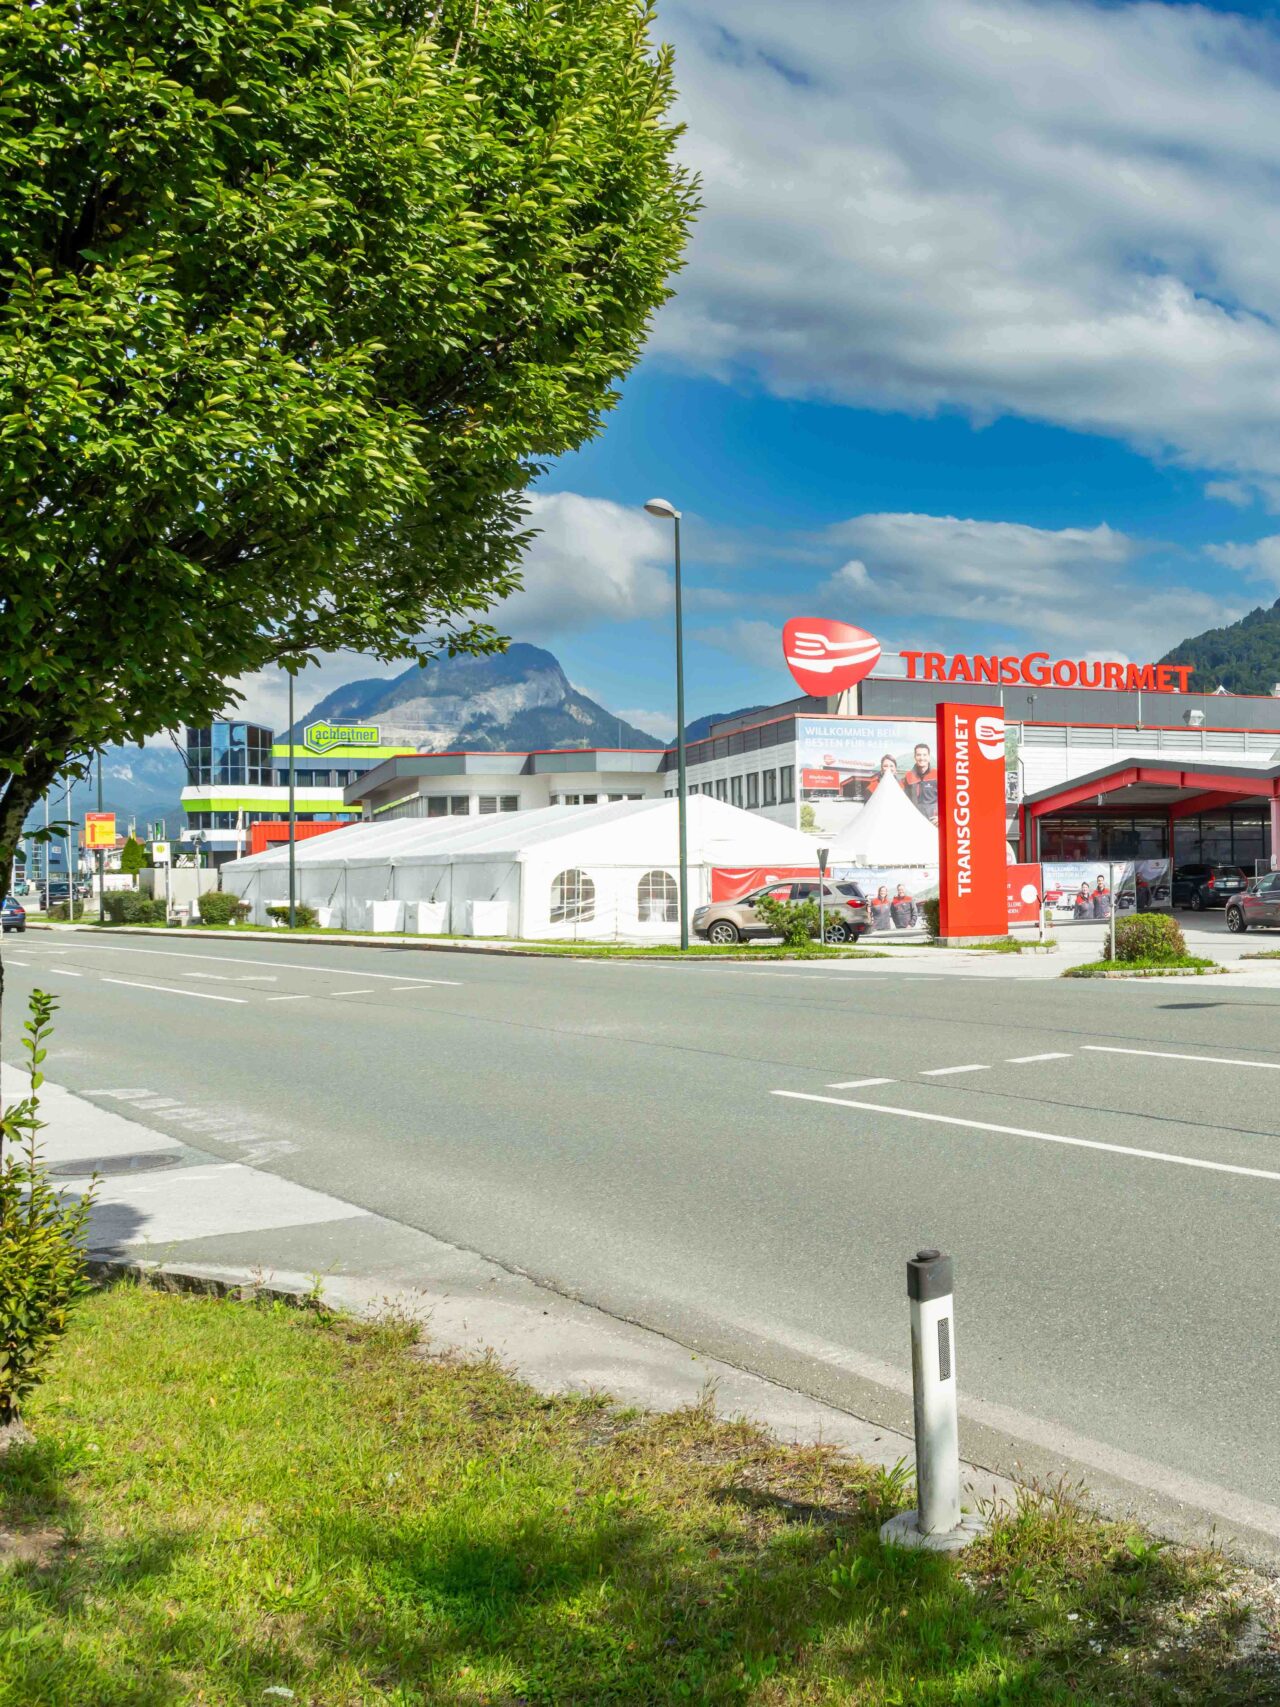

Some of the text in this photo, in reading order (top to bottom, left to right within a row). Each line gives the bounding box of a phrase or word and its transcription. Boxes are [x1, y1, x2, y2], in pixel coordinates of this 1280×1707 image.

[900, 651, 1194, 692] TRANSGOURMET
[315, 728, 375, 740] achleitner
[805, 727, 874, 737] WILLKOMMEN
[953, 714, 972, 897] TRANSGOURMET
